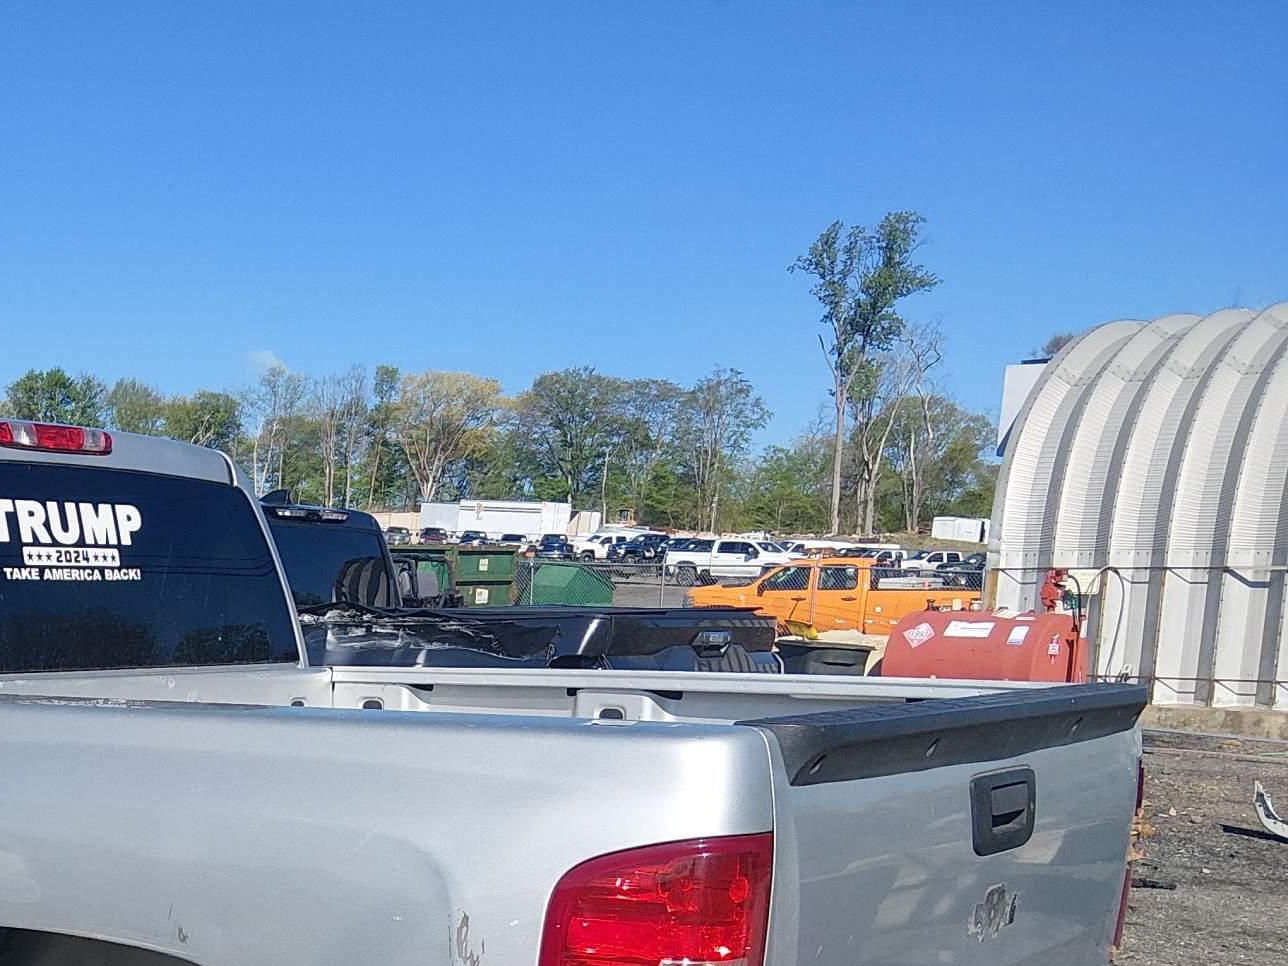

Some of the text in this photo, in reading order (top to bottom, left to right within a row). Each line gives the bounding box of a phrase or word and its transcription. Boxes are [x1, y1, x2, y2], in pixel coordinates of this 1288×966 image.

[55, 550, 91, 564] 2024
[3, 567, 142, 581] TAKE AMERICA BACK!
